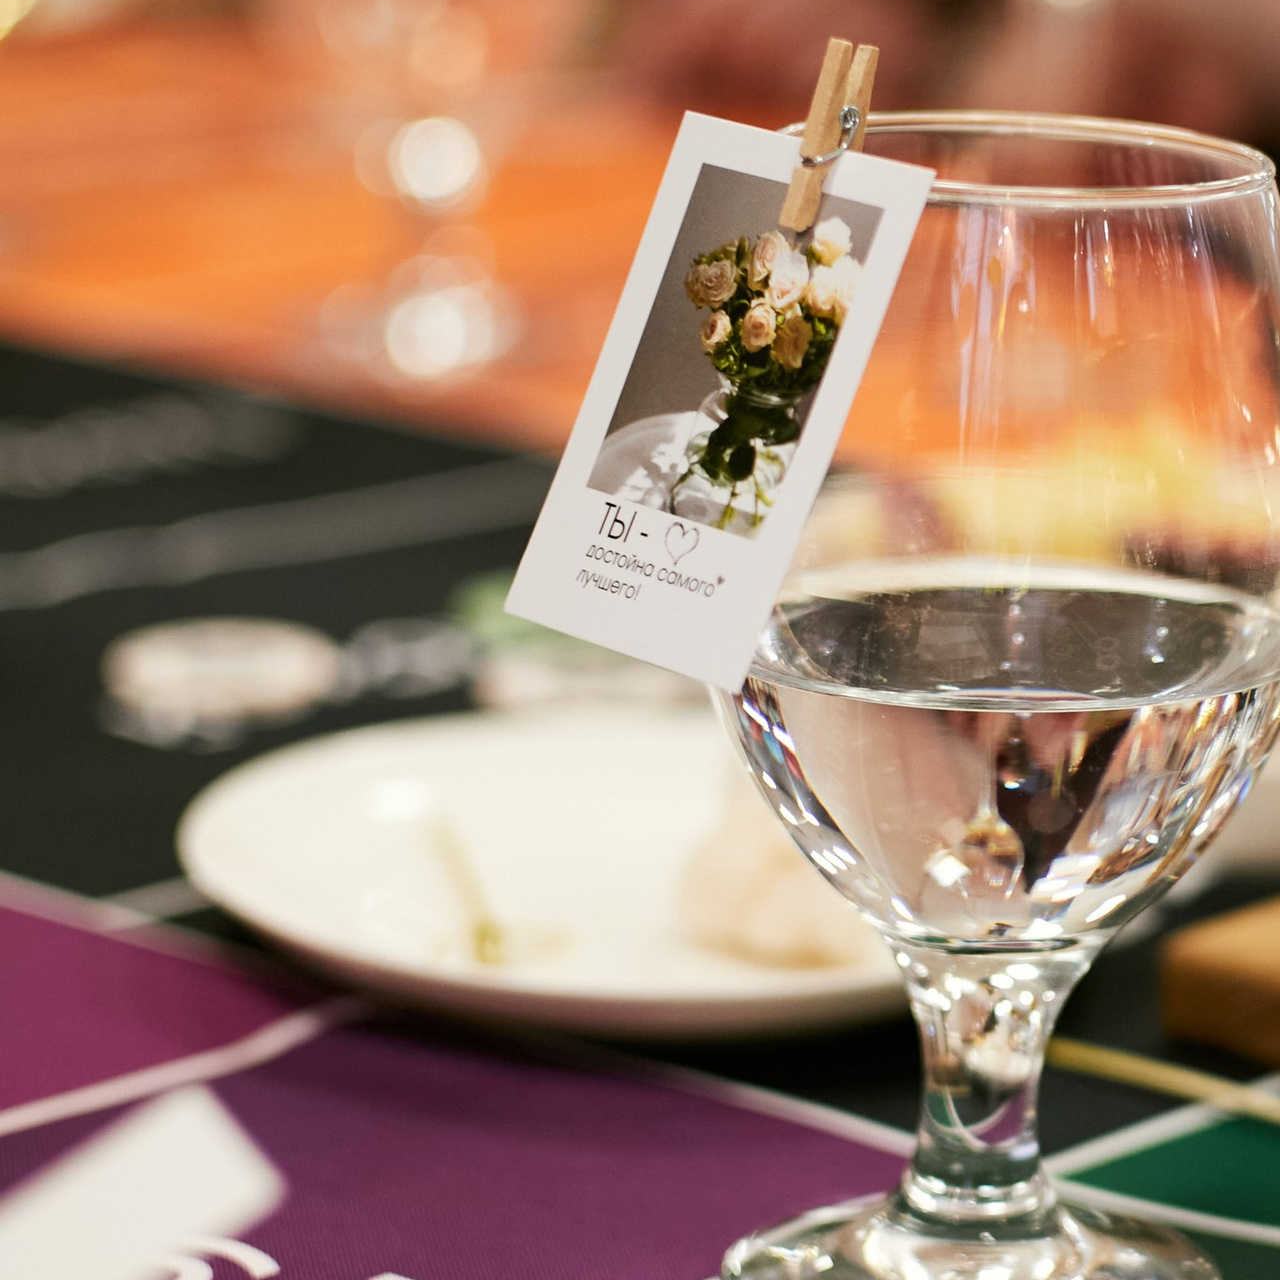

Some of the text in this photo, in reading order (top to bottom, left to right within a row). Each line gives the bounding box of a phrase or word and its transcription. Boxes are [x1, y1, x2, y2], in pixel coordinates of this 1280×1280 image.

[575, 568, 642, 601] лучшего!
[585, 544, 715, 598] достойна самого
